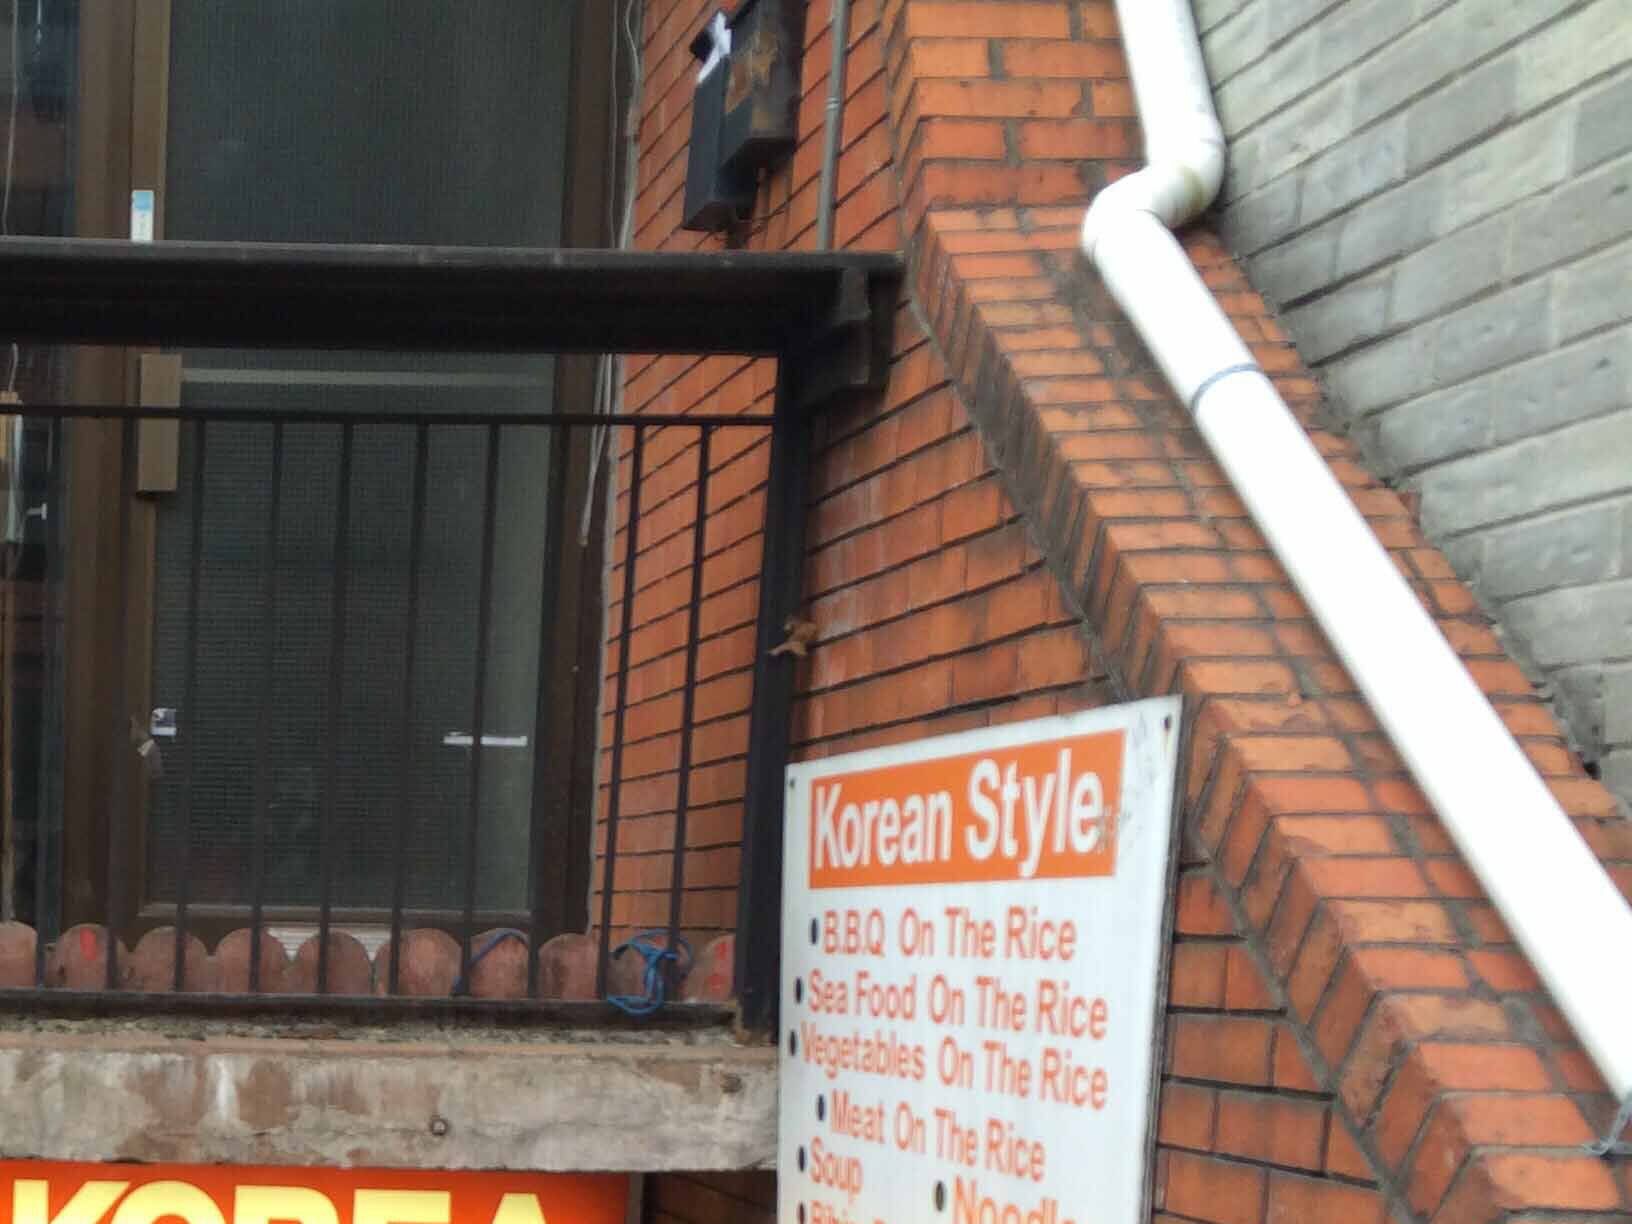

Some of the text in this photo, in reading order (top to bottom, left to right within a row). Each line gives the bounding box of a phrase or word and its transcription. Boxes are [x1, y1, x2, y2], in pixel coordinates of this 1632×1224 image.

[815, 748, 1105, 878] Korean Style
[898, 908, 935, 957] On
[945, 907, 996, 957] The
[1005, 906, 1076, 961] Rice
[808, 969, 1108, 1040] Sea Food On The Rice
[801, 1022, 1108, 1110] Vegetables On The Rice
[810, 1137, 863, 1197] Soup
[831, 1090, 1046, 1182] Meat On The Rice
